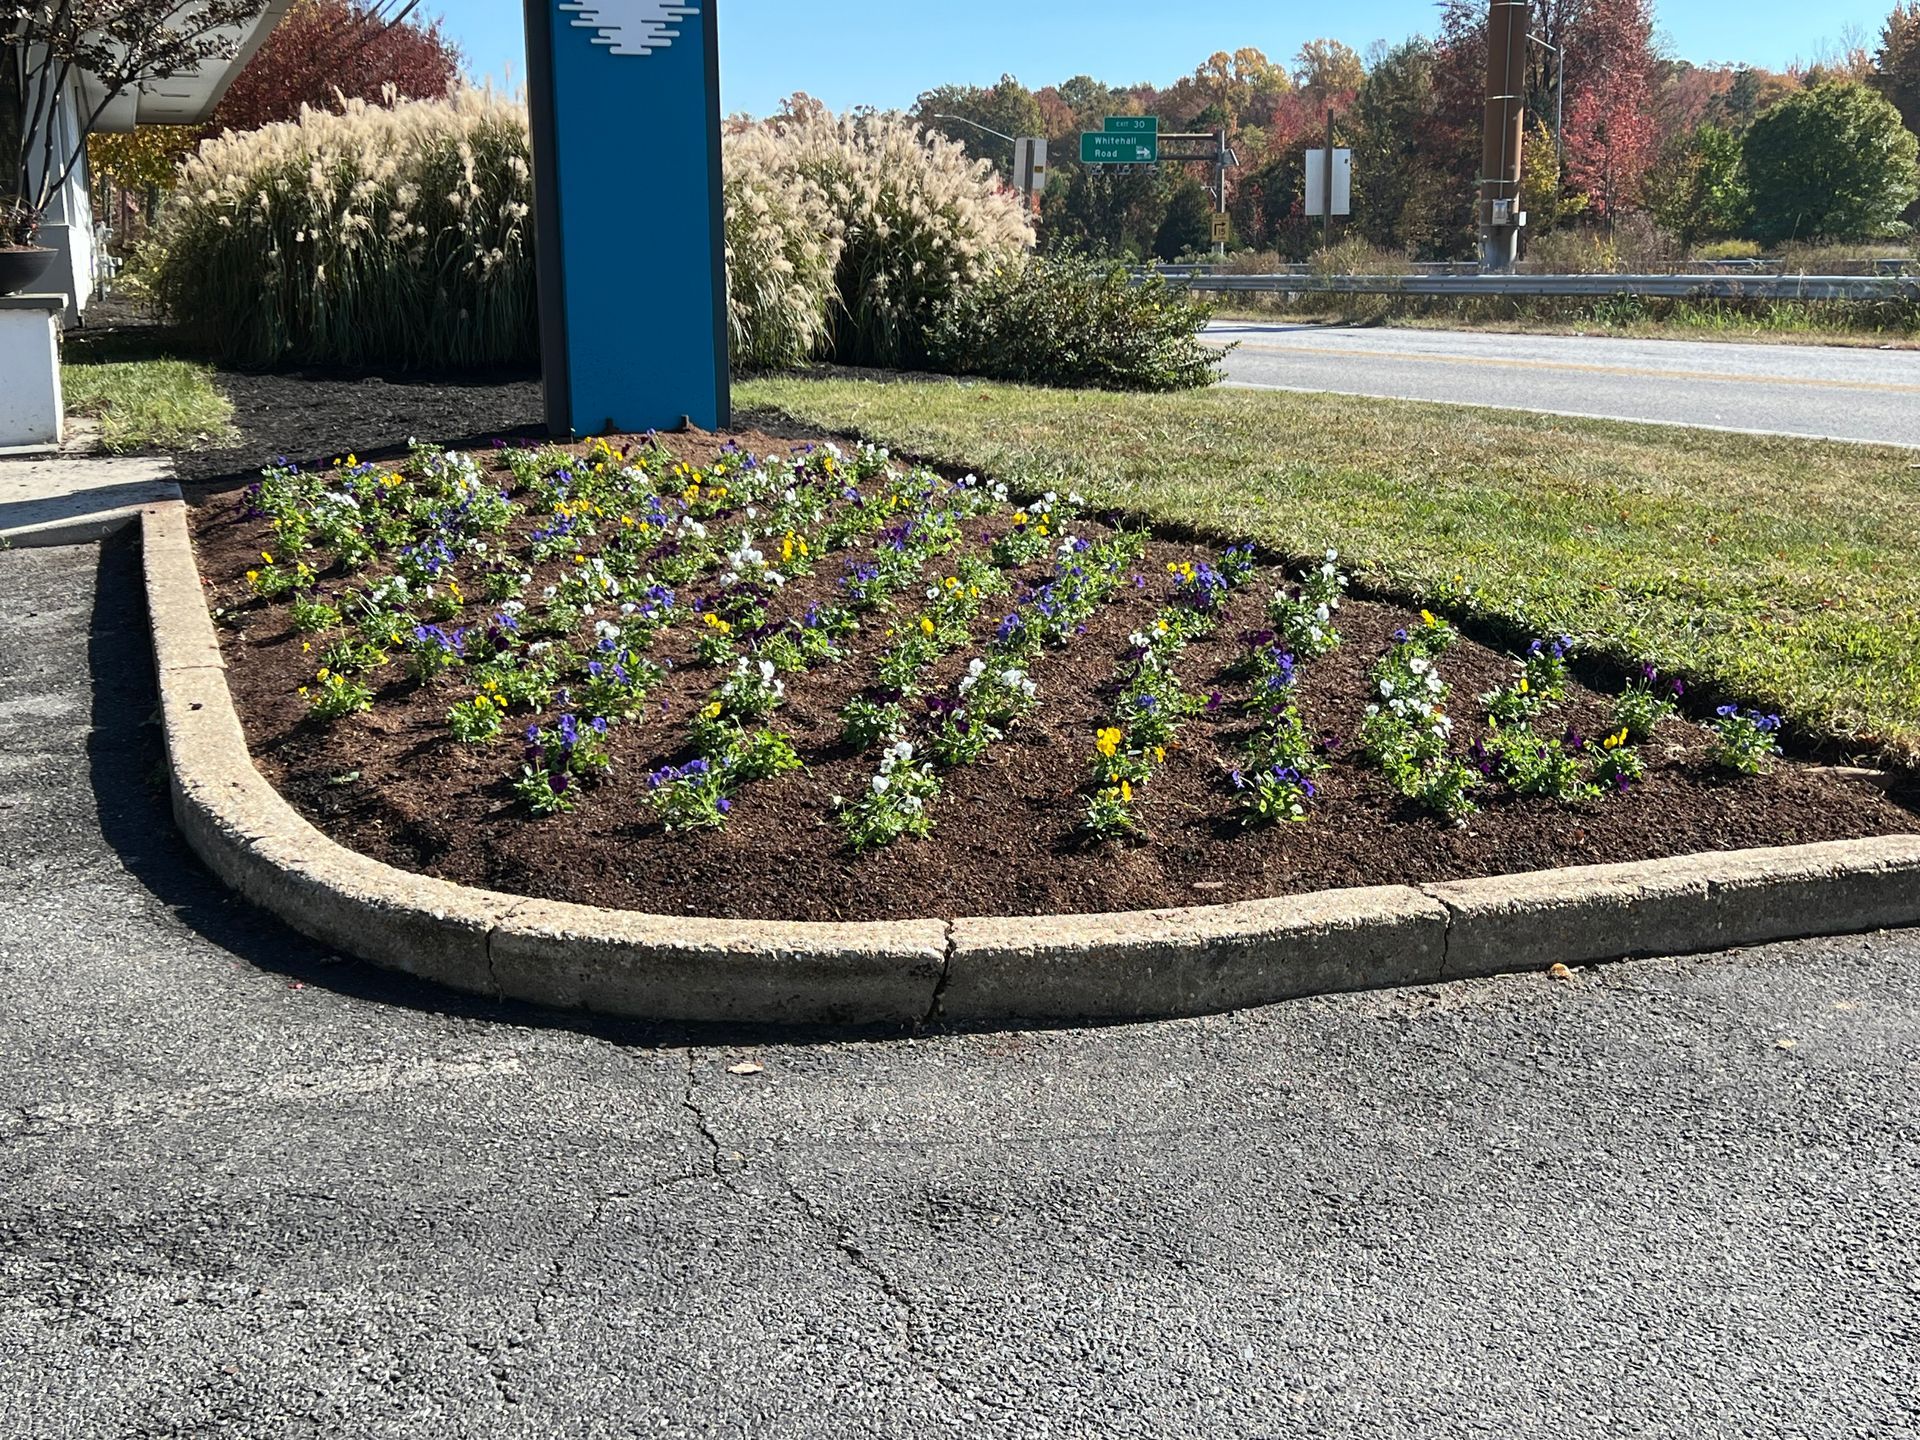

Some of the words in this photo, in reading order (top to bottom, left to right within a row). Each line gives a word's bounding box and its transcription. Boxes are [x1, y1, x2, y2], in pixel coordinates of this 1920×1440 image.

[1133, 120, 1145, 129] 30
[1094, 137, 1137, 145] Whitehall
[1094, 149, 1118, 157] Road
